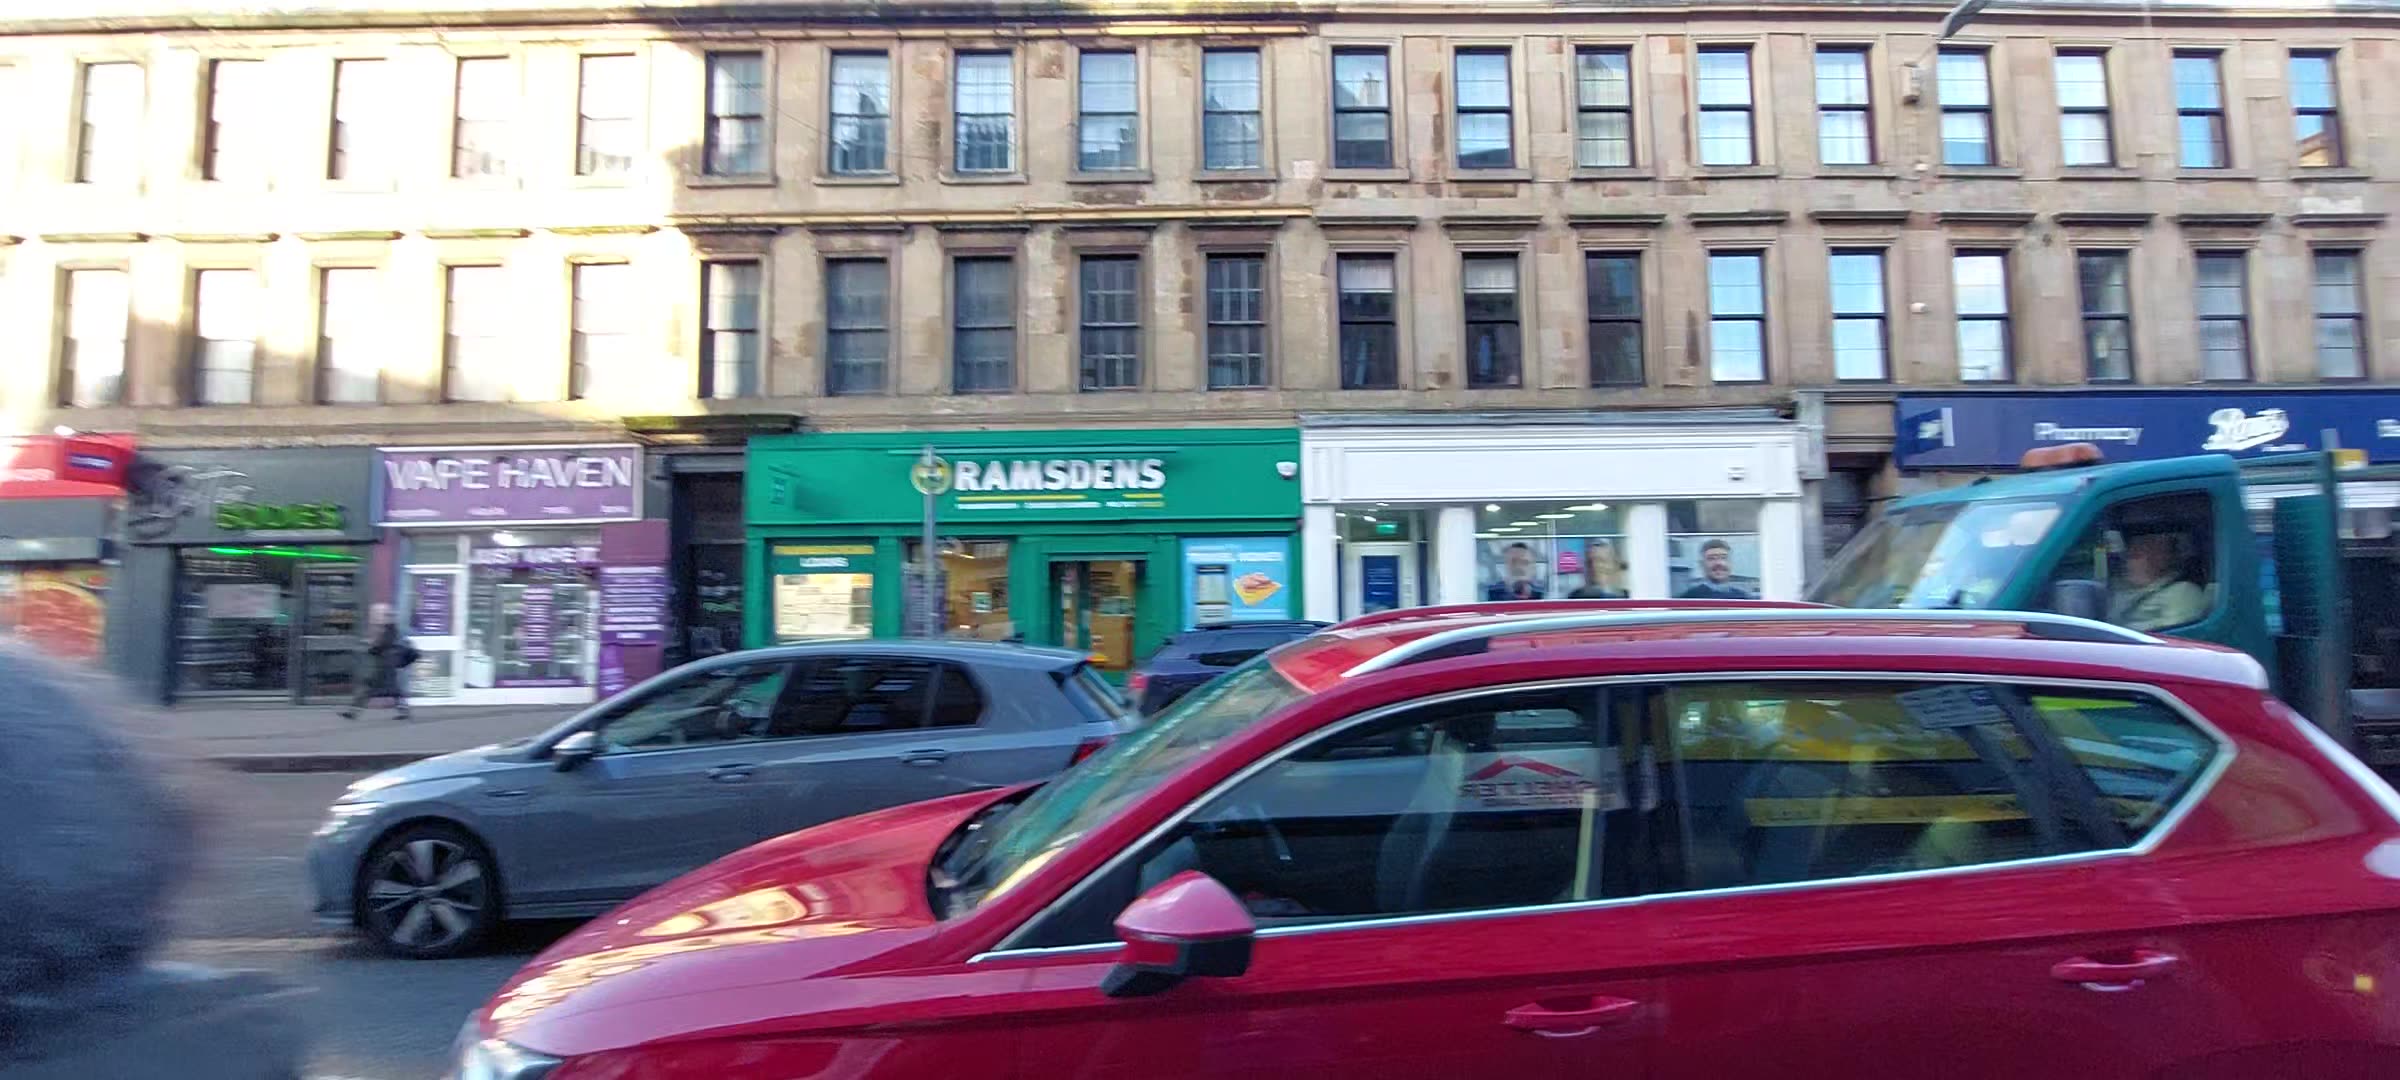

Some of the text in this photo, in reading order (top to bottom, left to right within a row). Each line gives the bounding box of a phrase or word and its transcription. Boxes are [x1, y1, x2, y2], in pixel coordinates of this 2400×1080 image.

[2034, 421, 2142, 445] Pharmacy
[385, 455, 633, 490] VAPE HAVEN
[954, 458, 1166, 491] RAMSDENS
